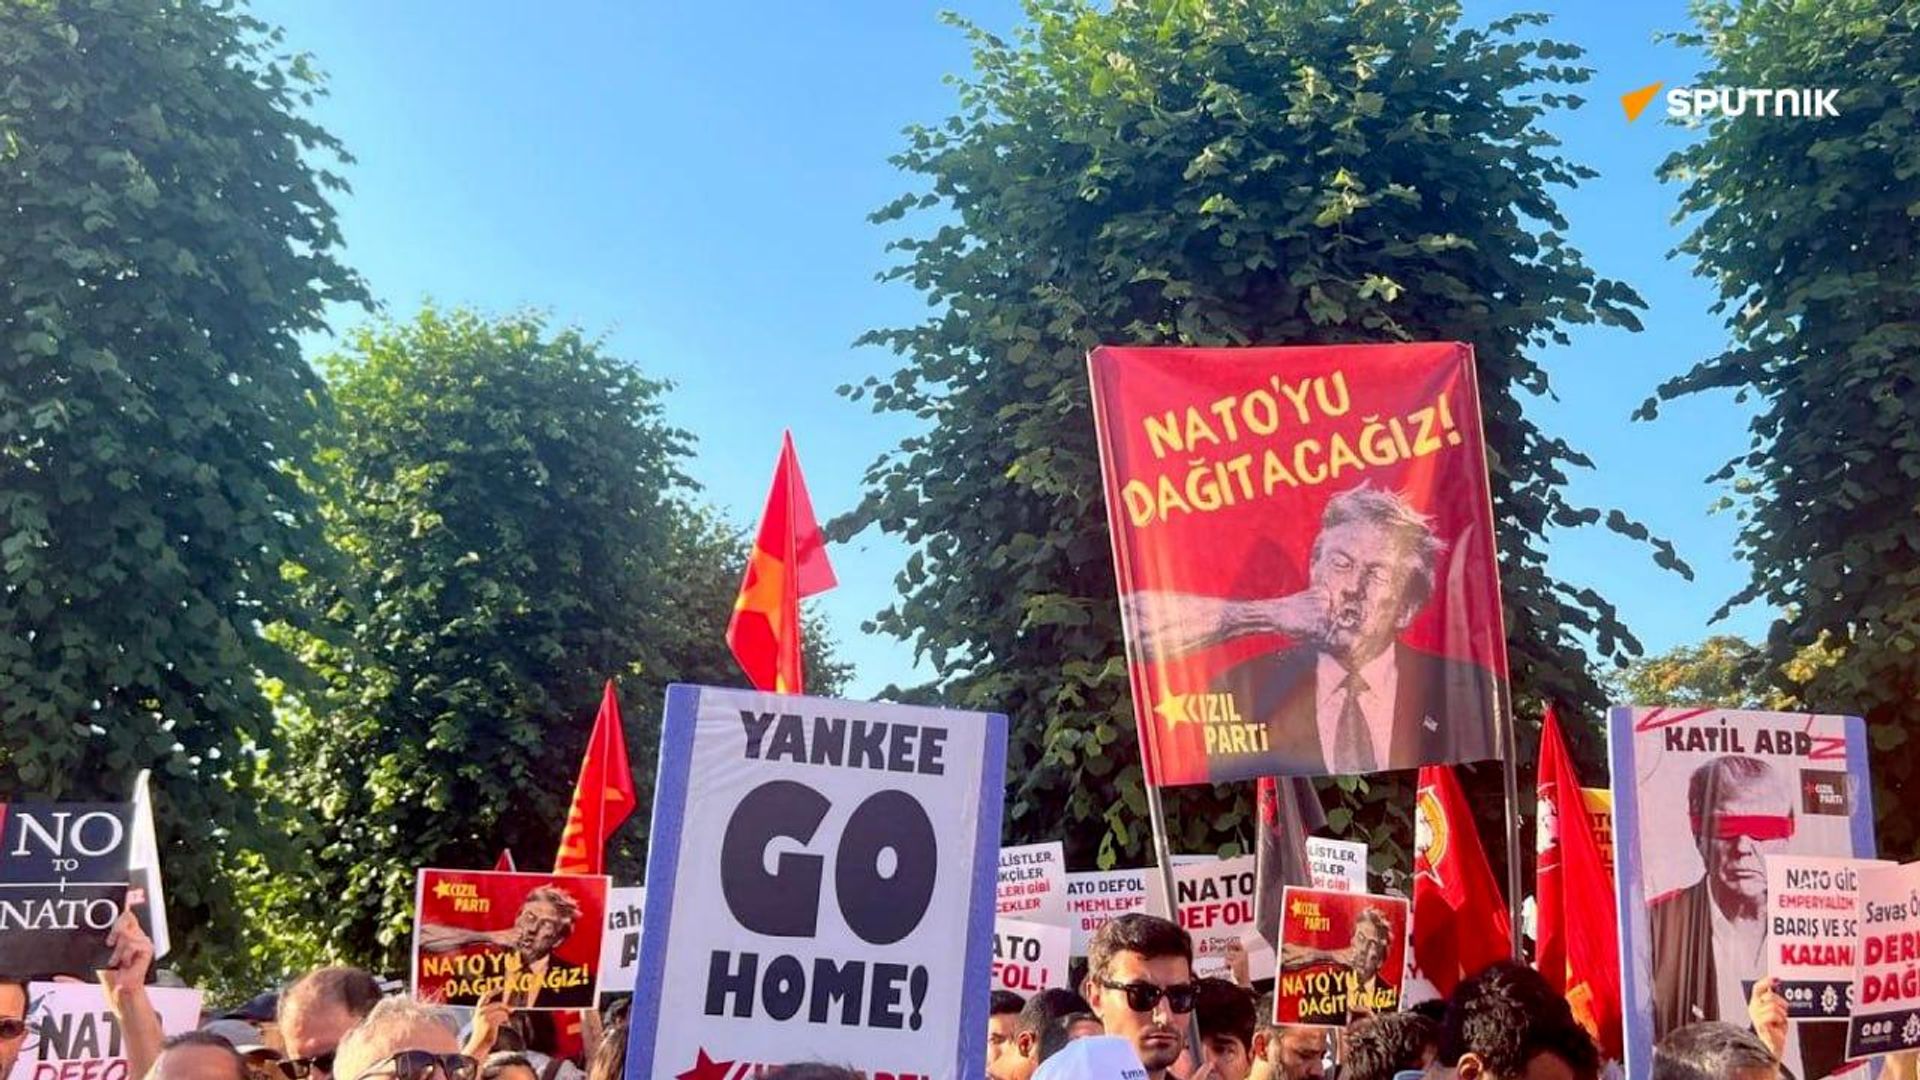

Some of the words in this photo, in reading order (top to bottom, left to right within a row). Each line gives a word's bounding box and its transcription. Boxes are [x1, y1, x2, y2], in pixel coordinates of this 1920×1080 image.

[1143, 370, 1350, 459] NATO'YU
[1121, 395, 1462, 528] DAĞITACAĞIZ!
[740, 710, 948, 776] YANKEE
[1206, 723, 1269, 755] PARTİ
[1665, 718, 1743, 753] KATİL
[1755, 730, 1813, 756] ABD
[12, 811, 123, 857] NO
[52, 858, 79, 872] TO
[720, 779, 938, 945] GO
[1099, 879, 1144, 893] DEFOL
[1178, 872, 1254, 903] NATO
[1786, 869, 1831, 890] NATO
[1, 899, 118, 931] NATO
[1773, 917, 1818, 938] BARIŞ
[1822, 918, 1839, 937] VE
[423, 950, 523, 977] NATO'YU
[704, 950, 929, 1031] HOME!
[1282, 967, 1358, 997] NATO'YU
